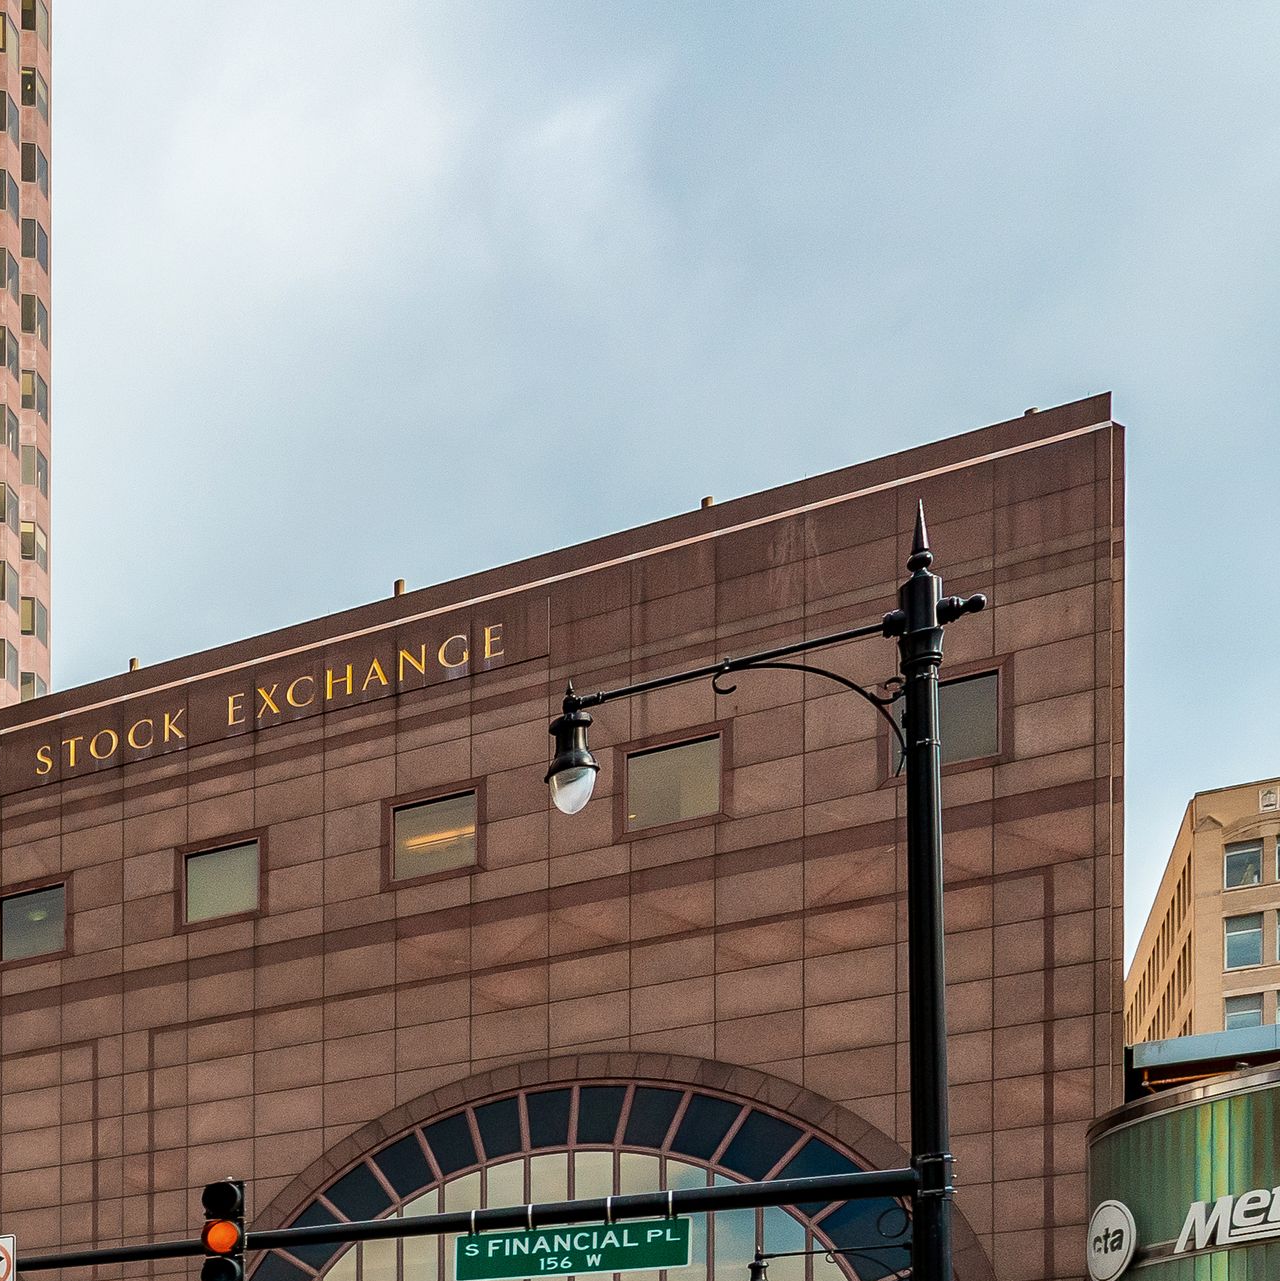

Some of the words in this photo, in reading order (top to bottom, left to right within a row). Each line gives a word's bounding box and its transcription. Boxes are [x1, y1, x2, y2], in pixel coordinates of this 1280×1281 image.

[35, 708, 186, 775] STOCK
[227, 623, 505, 726] EXCHANGE
[465, 1244, 480, 1257] S
[487, 1229, 639, 1258] FINANCIAL
[646, 1229, 681, 1243] PL
[1092, 1227, 1124, 1255] cta
[540, 1257, 573, 1271] 156
[586, 1254, 602, 1267] W
